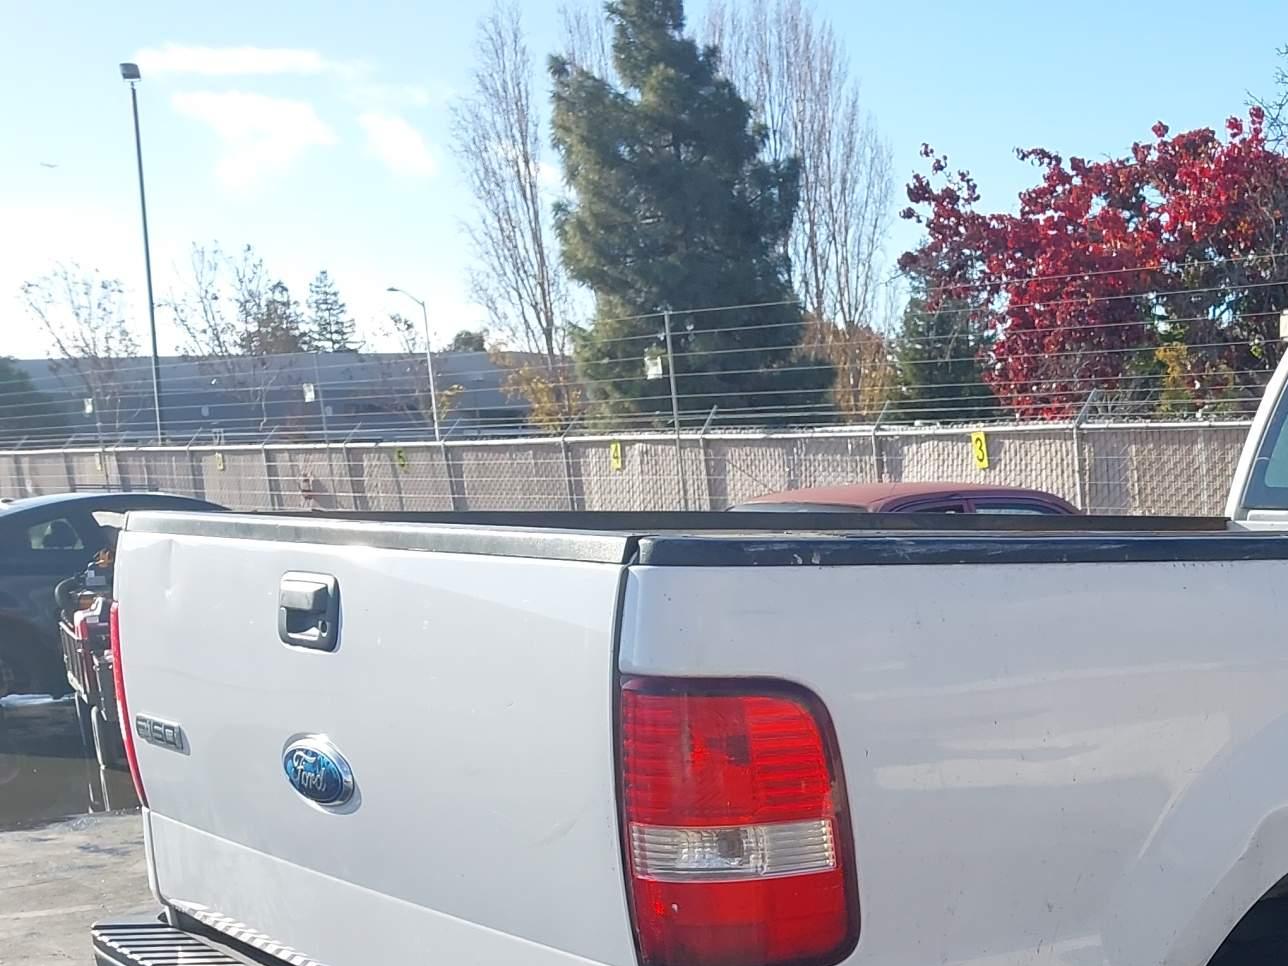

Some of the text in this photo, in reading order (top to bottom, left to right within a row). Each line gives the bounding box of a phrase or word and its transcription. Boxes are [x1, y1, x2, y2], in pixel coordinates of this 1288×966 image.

[612, 443, 620, 465] 4
[975, 437, 985, 462] 3
[292, 750, 328, 792] Ford
